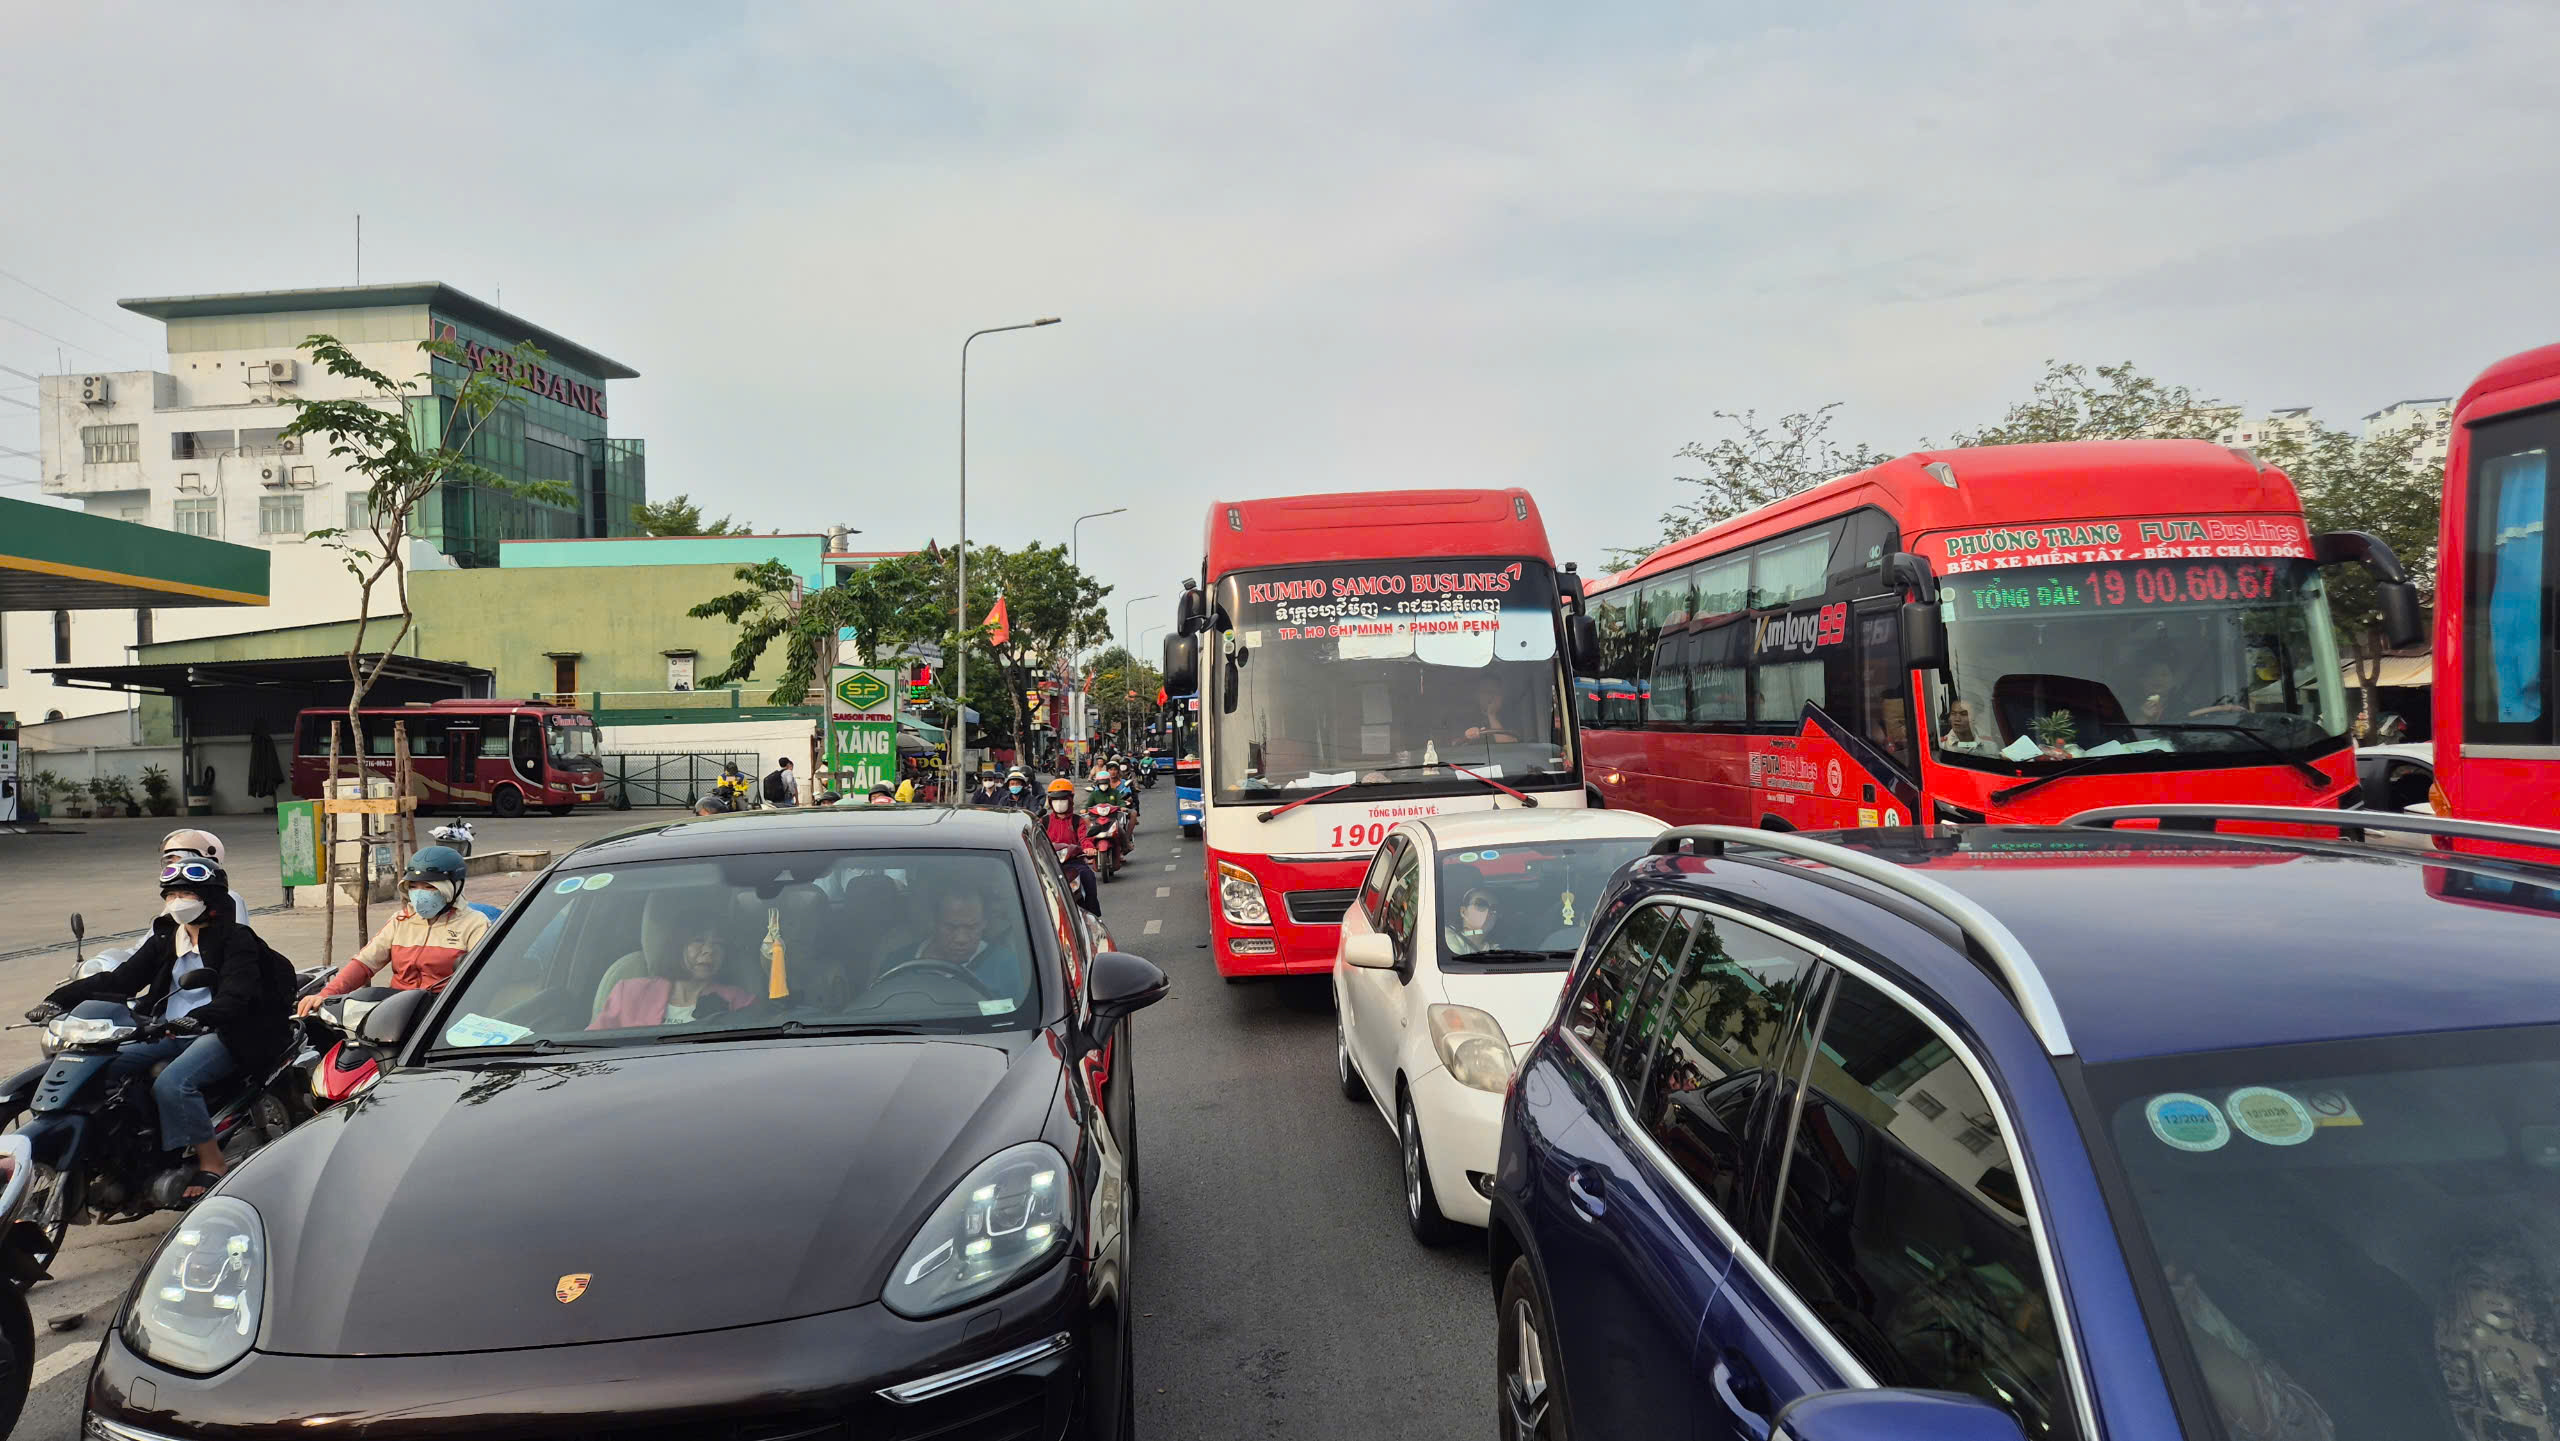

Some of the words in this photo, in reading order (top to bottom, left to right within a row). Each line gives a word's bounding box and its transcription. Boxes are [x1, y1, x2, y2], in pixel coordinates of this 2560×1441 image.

[1945, 528, 2039, 557] PHƯƠNG
[2042, 524, 2121, 548] TRANG
[1946, 555, 1989, 574] BẾN
[1994, 557, 2022, 569] XE
[2027, 548, 2077, 566] MIỀN
[2081, 547, 2124, 562] TÂY
[2145, 542, 2182, 559] BẾN
[2187, 546, 2211, 558] XE
[2212, 543, 2267, 558] CHÂU
[2271, 542, 2305, 558] ĐỐC
[1248, 579, 1327, 604] KUMHO
[1332, 575, 1406, 597] SAMCO
[1410, 572, 1511, 594] BUSLINES
[1972, 577, 2031, 609] TỔNG
[2086, 569, 2126, 606] 19
[1279, 628, 1302, 641] TP.
[1304, 625, 1326, 639] HO
[1328, 624, 1354, 638] CHI
[1356, 623, 1394, 636] MINH
[1409, 621, 1459, 634] PHNOM
[1463, 619, 1500, 632] PENH
[846, 683, 880, 696] SP
[833, 712, 864, 721] SAIGON
[865, 713, 892, 722] PETRO
[837, 725, 889, 755] XĂNG
[1368, 805, 1391, 818] TỔNG
[1331, 821, 1401, 848] 190
